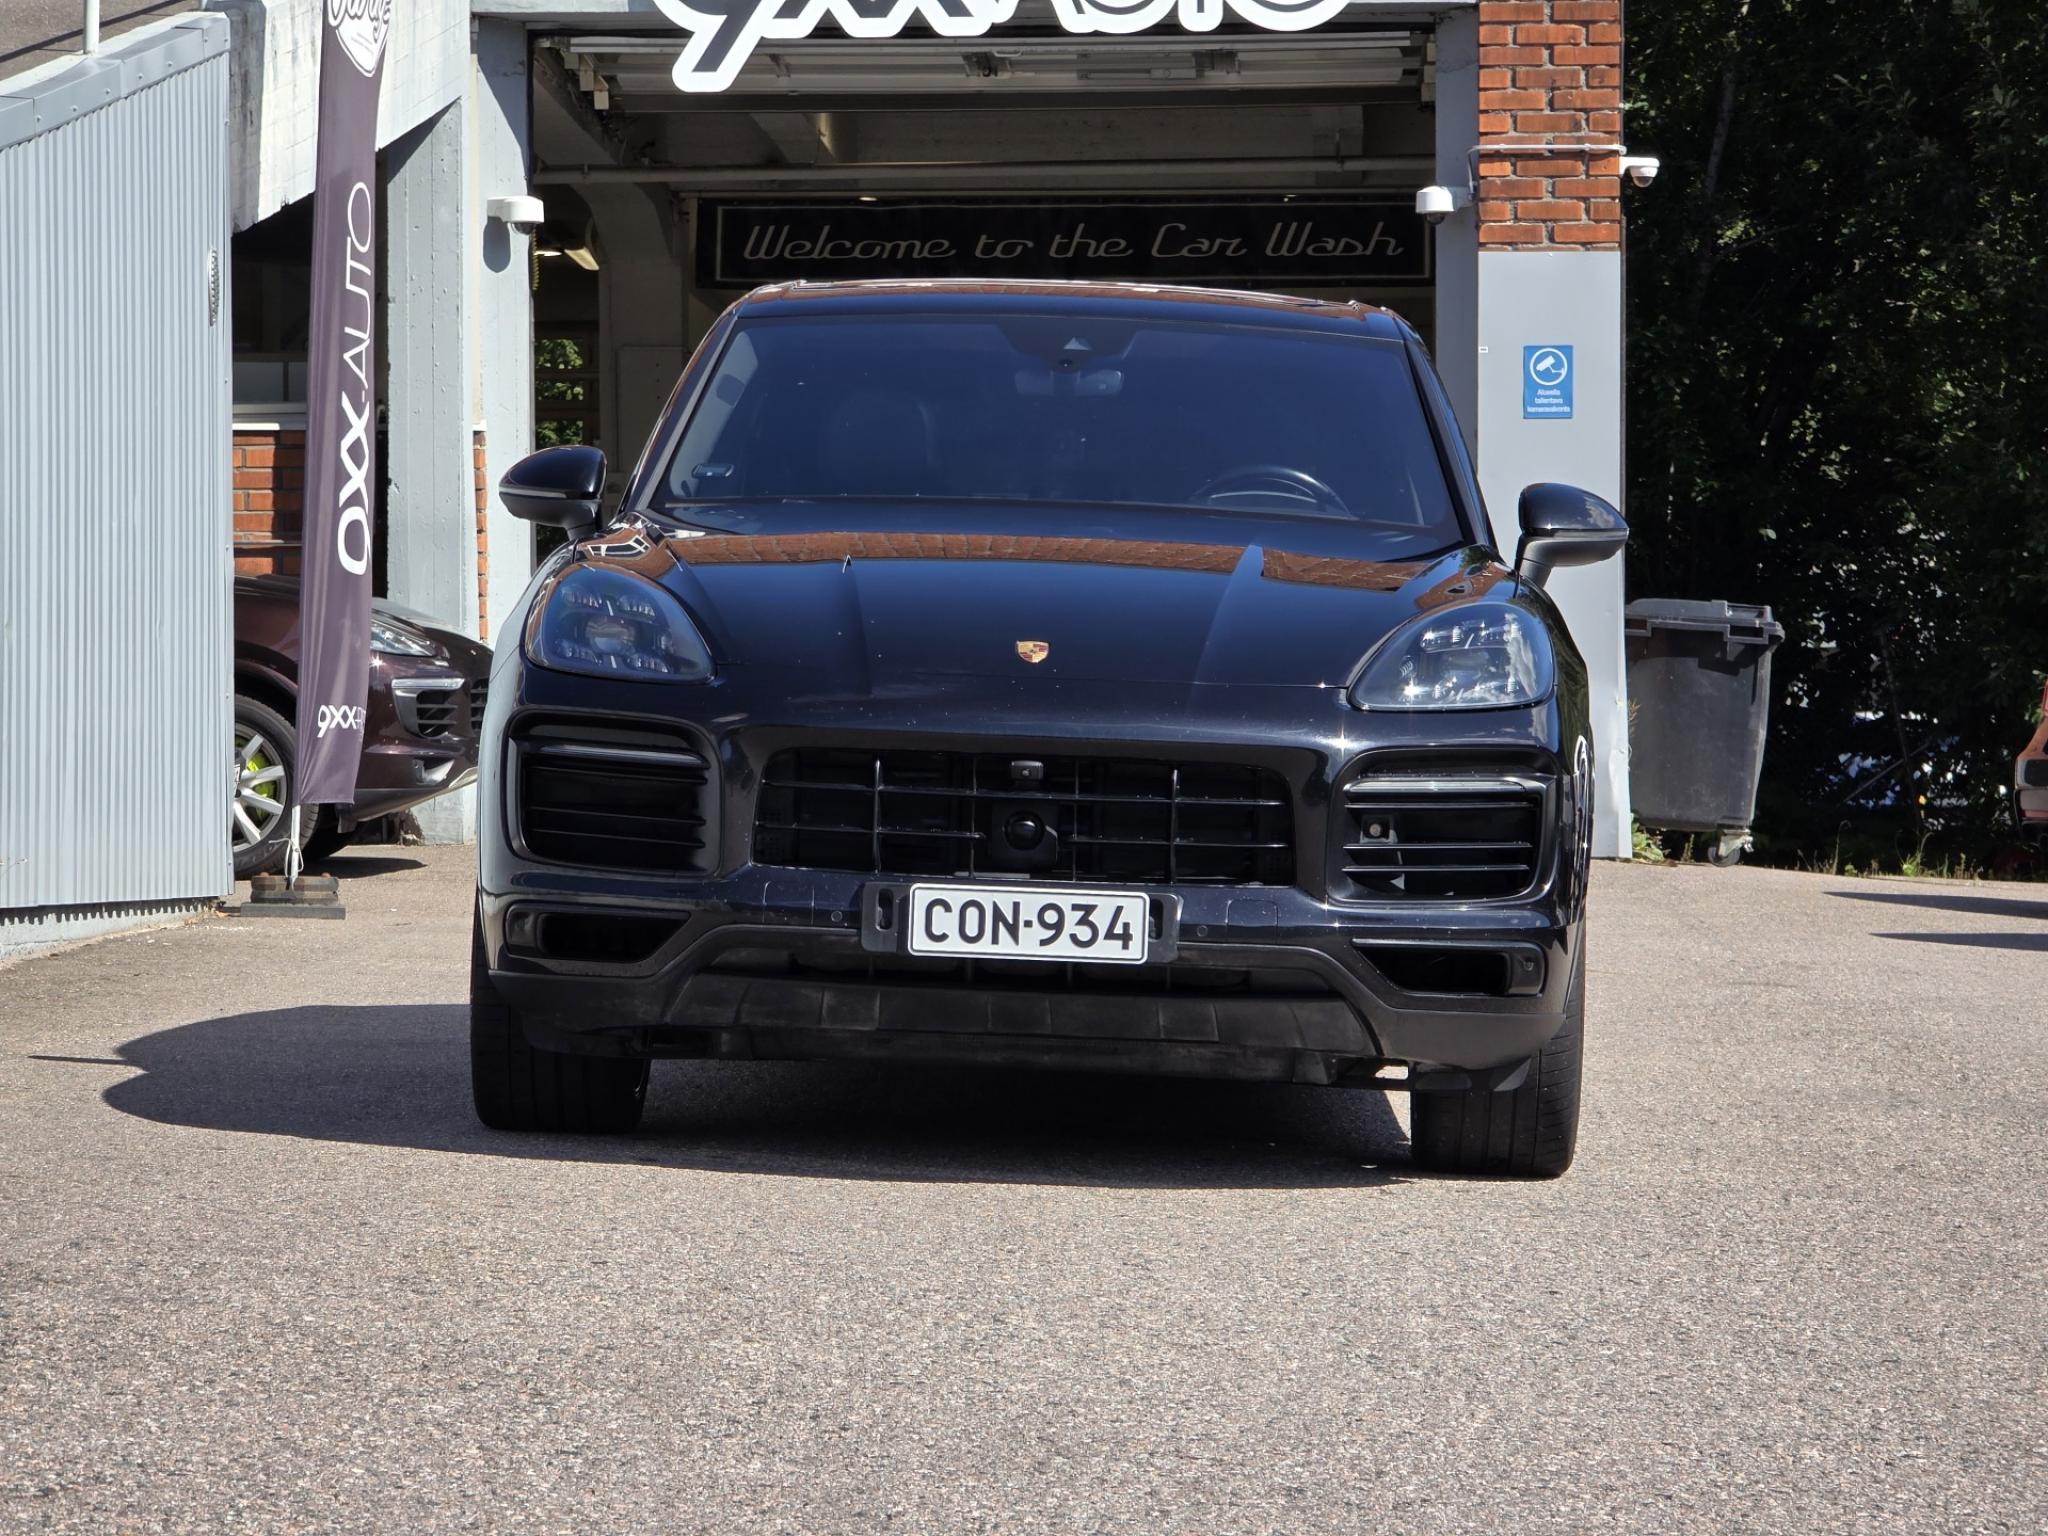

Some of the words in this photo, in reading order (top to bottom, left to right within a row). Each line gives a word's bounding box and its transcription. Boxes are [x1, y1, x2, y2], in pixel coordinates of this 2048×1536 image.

[743, 225, 957, 260] Welcome
[974, 234, 1035, 259] to
[1049, 223, 1135, 258] the
[1151, 223, 1249, 258] Car
[1265, 221, 1405, 257] Wash
[924, 897, 1134, 951] CON-934
